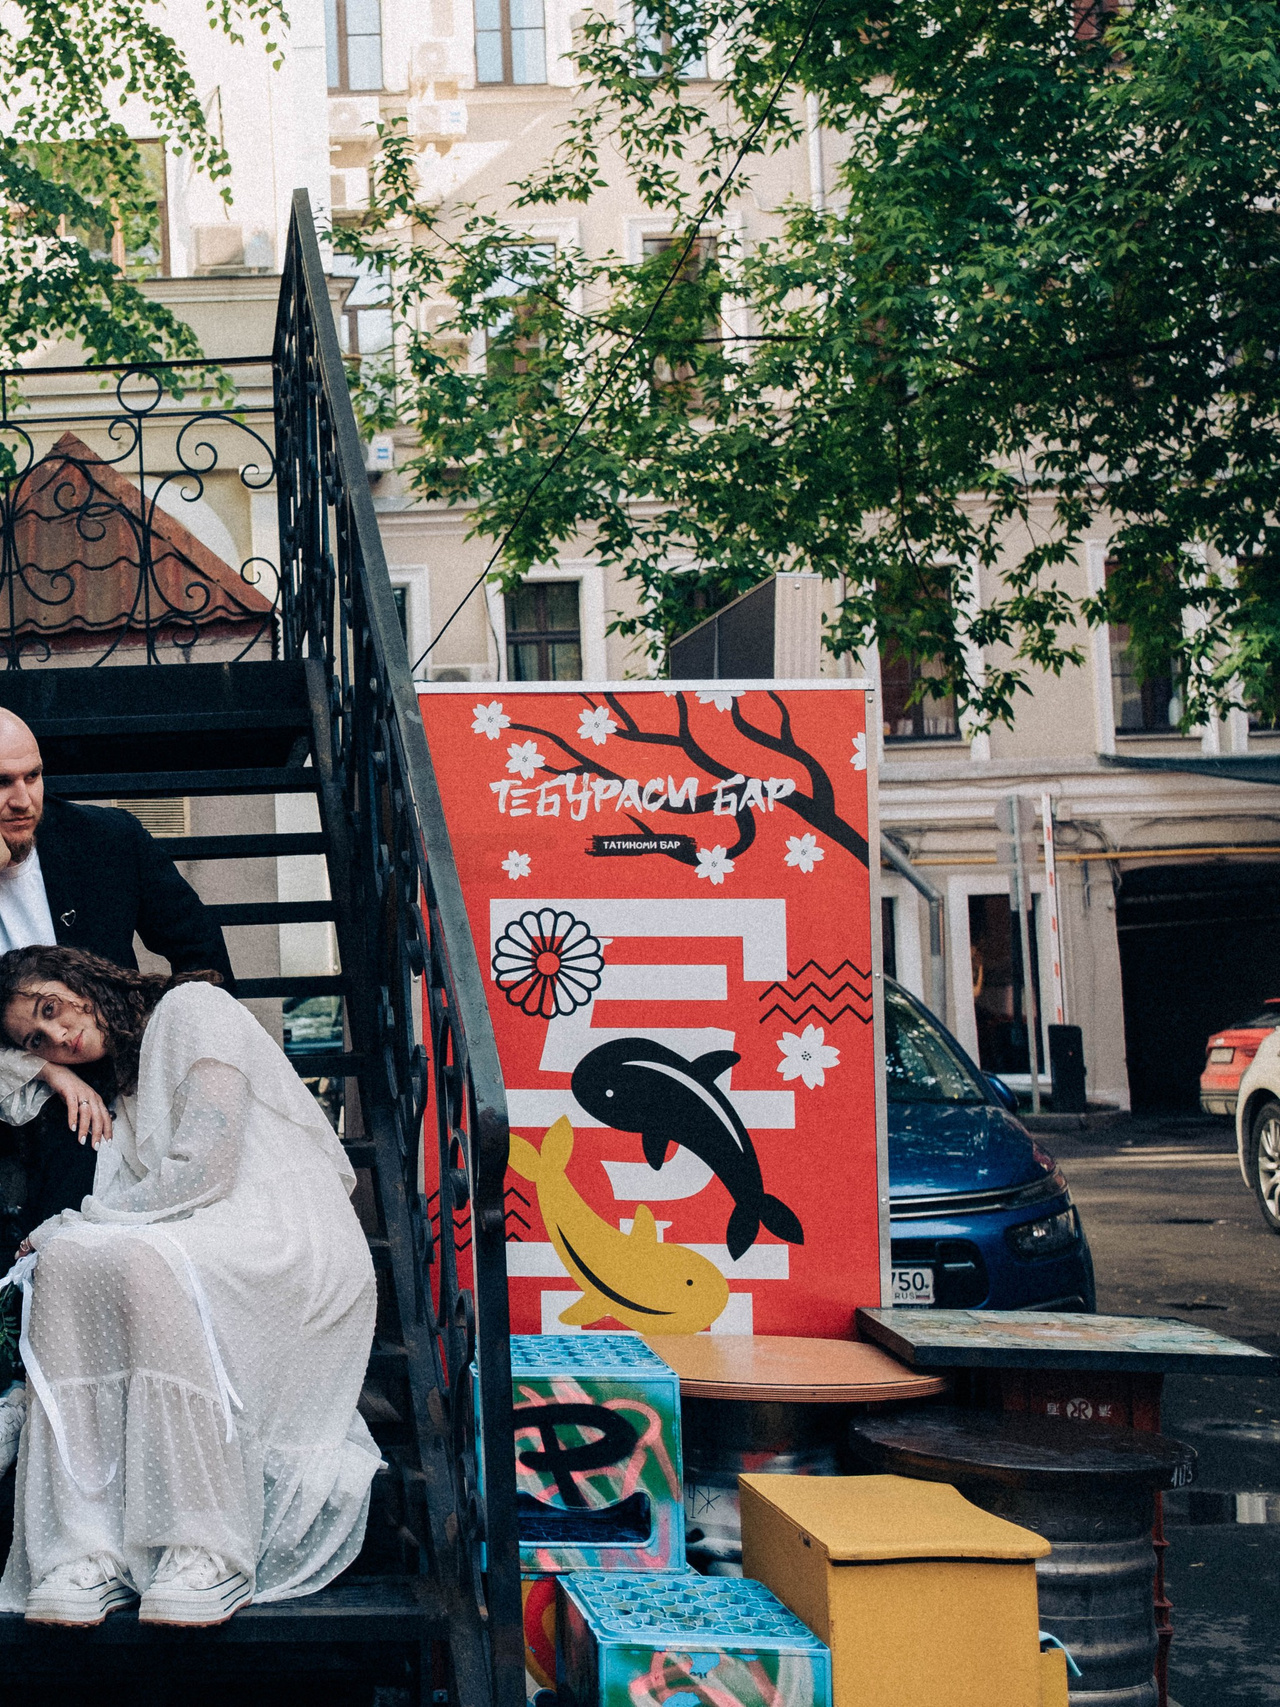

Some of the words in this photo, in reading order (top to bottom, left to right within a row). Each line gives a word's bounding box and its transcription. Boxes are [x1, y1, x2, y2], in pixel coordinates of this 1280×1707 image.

[489, 772, 699, 821] ТЕБУРАСИ
[712, 773, 796, 816] БАР
[602, 840, 657, 851] ТАТИНОМИ
[659, 840, 681, 851] БАР
[894, 1292, 915, 1300] RUS
